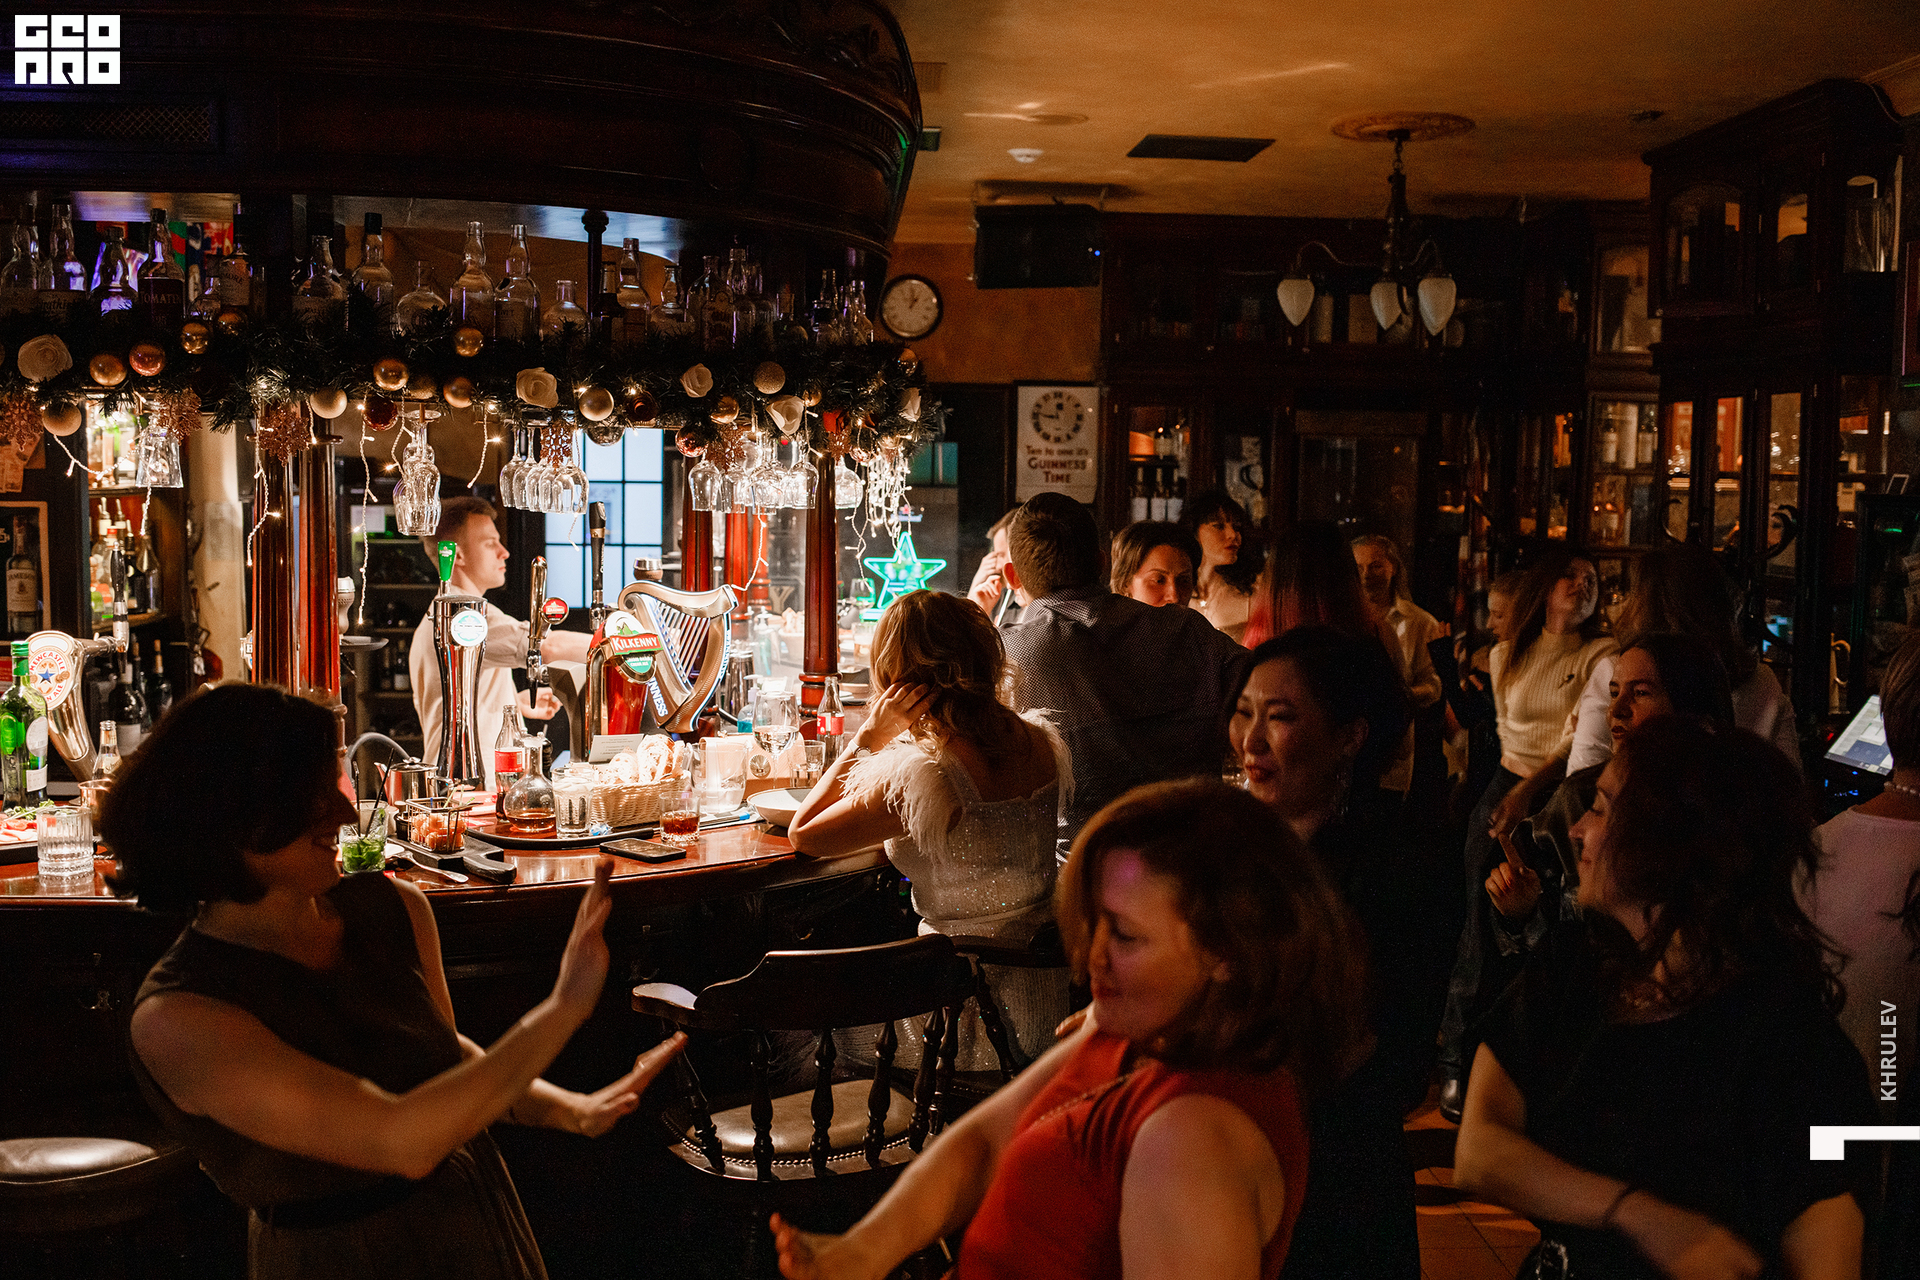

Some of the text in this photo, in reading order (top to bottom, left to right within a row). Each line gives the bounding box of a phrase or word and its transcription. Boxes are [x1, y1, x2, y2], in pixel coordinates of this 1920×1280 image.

[612, 637, 658, 651] KILKENNY
[29, 651, 66, 672] NEWCASTLE
[53, 685, 64, 698] ALE
